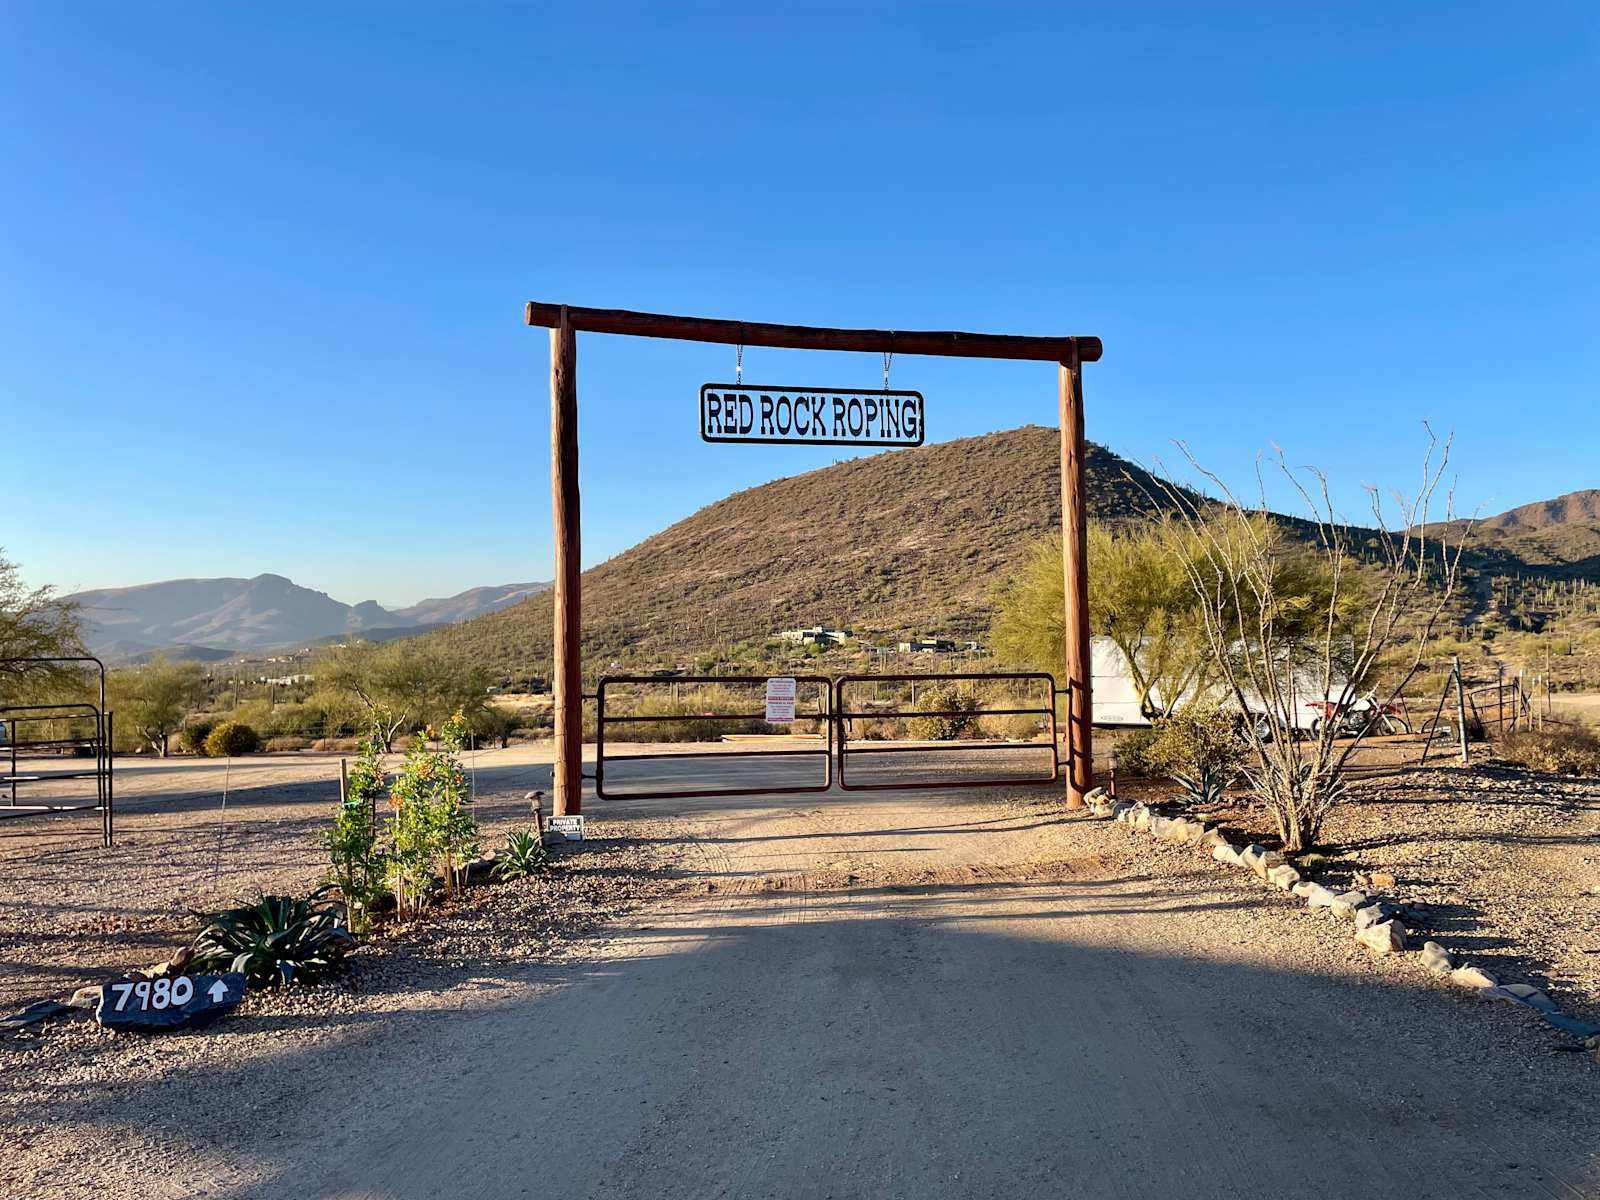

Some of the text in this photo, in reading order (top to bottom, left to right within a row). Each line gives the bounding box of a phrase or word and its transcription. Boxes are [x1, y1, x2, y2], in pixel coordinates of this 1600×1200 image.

[707, 393, 917, 438] RED ROCK ROPING
[112, 975, 194, 1011] 7980
